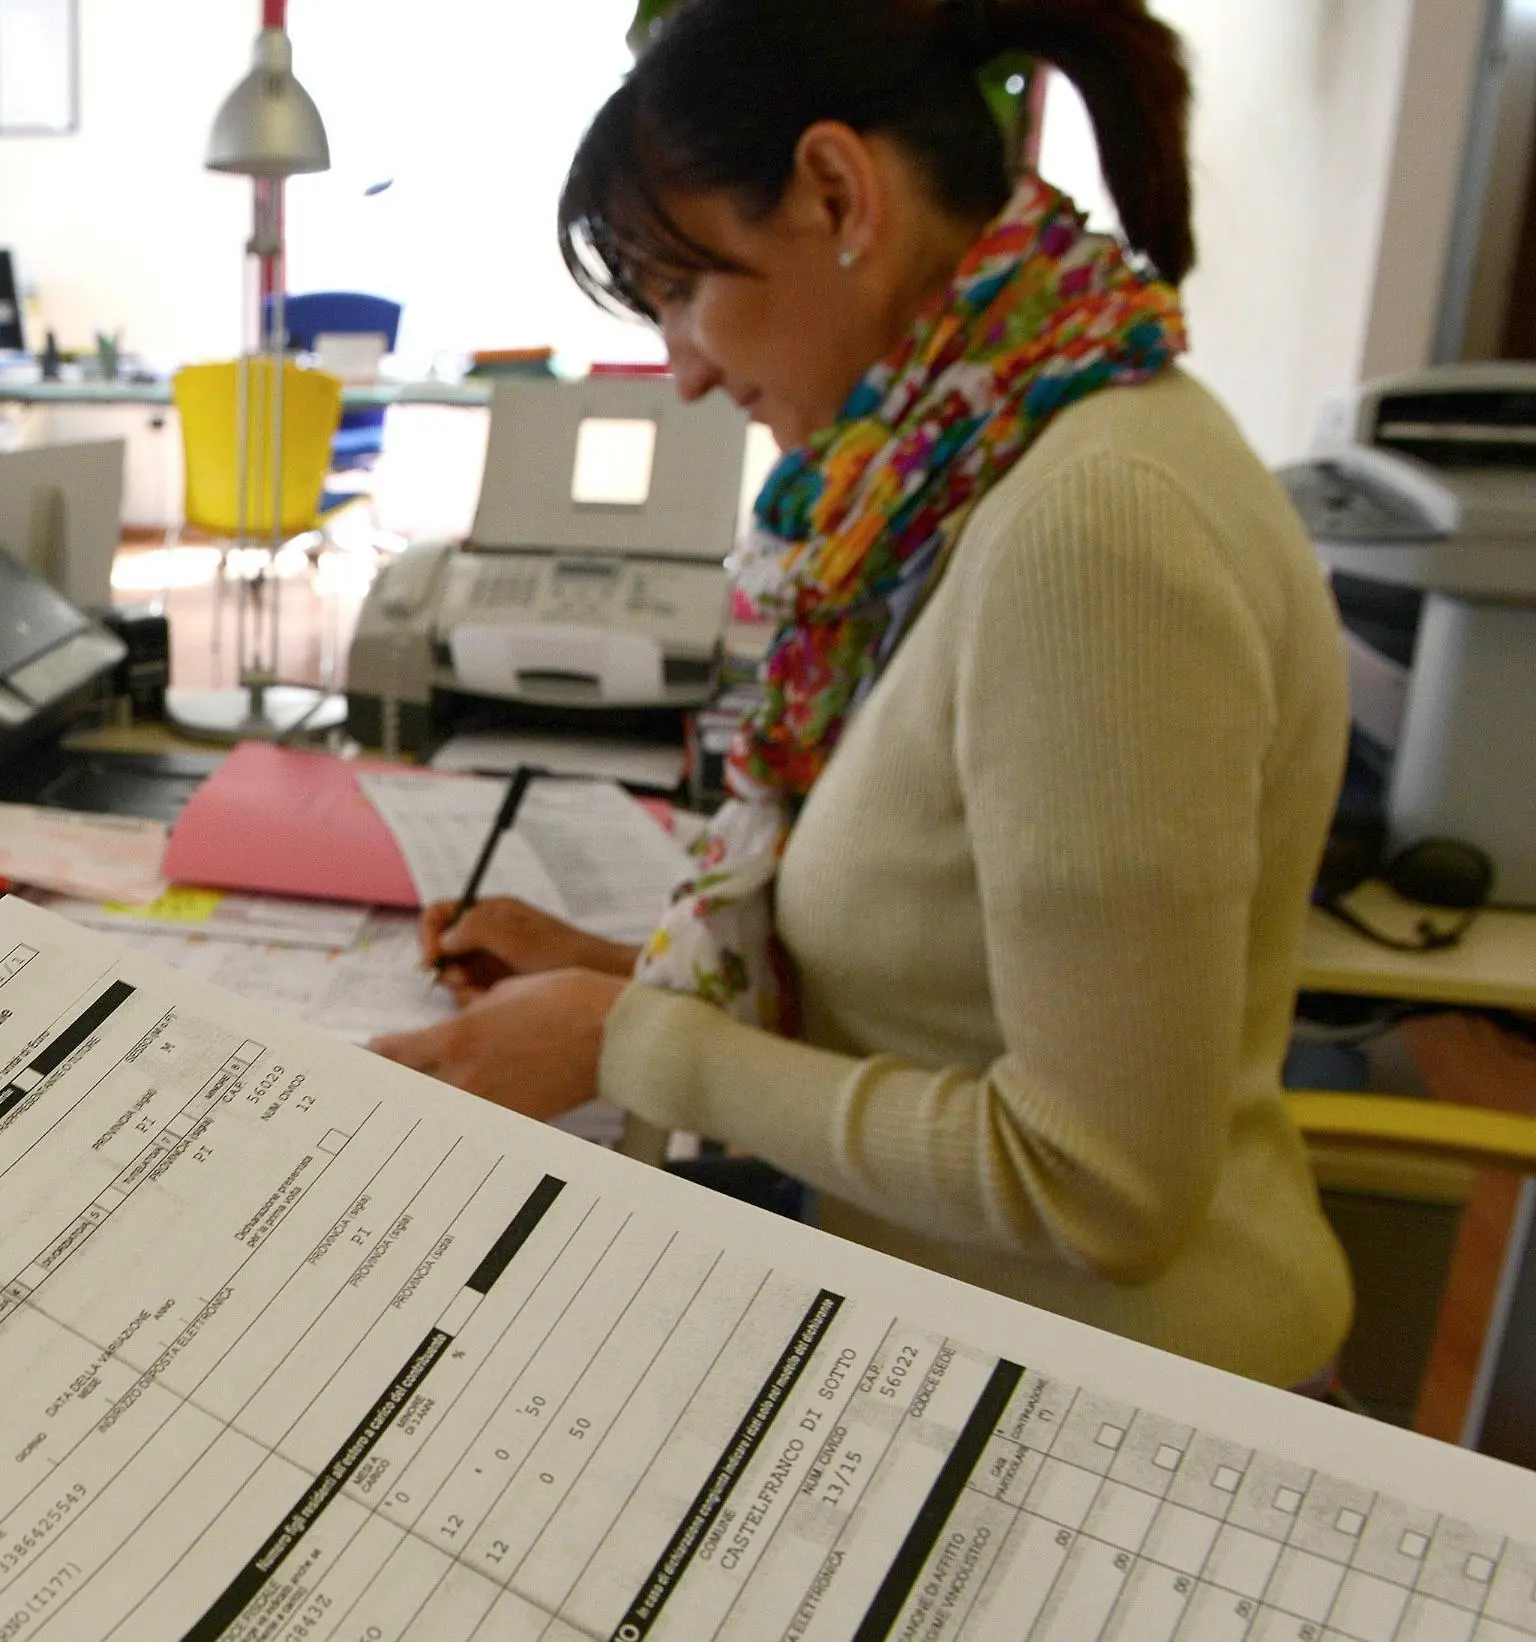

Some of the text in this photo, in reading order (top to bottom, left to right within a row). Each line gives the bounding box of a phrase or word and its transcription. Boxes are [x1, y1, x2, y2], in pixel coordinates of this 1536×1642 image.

[244, 1063, 287, 1104] 56029
[293, 1093, 318, 1113] 12
[132, 1115, 158, 1134] PI
[189, 1143, 215, 1164] PI
[232, 1153, 315, 1241] Dichiarazione presentata
[306, 1217, 354, 1266] PROVINCIA
[348, 1224, 373, 1246] PI
[347, 1237, 395, 1288] PROVINCIA
[391, 1257, 438, 1310] PROVINCIA
[877, 1344, 920, 1398] 56022
[930, 1345, 957, 1378] SEDE
[522, 1393, 548, 1418] 50
[567, 1415, 593, 1440] 50
[492, 1446, 511, 1462] 0
[715, 1346, 859, 1570] CASTELFRANCO DI SOTTO
[816, 1425, 850, 1465] CIVICO
[537, 1469, 556, 1486] 0
[818, 1449, 866, 1507] 13/15
[393, 1488, 412, 1506] 0
[438, 1511, 465, 1539] 12
[695, 1507, 740, 1560] COMUNE
[484, 1537, 510, 1565] 12
